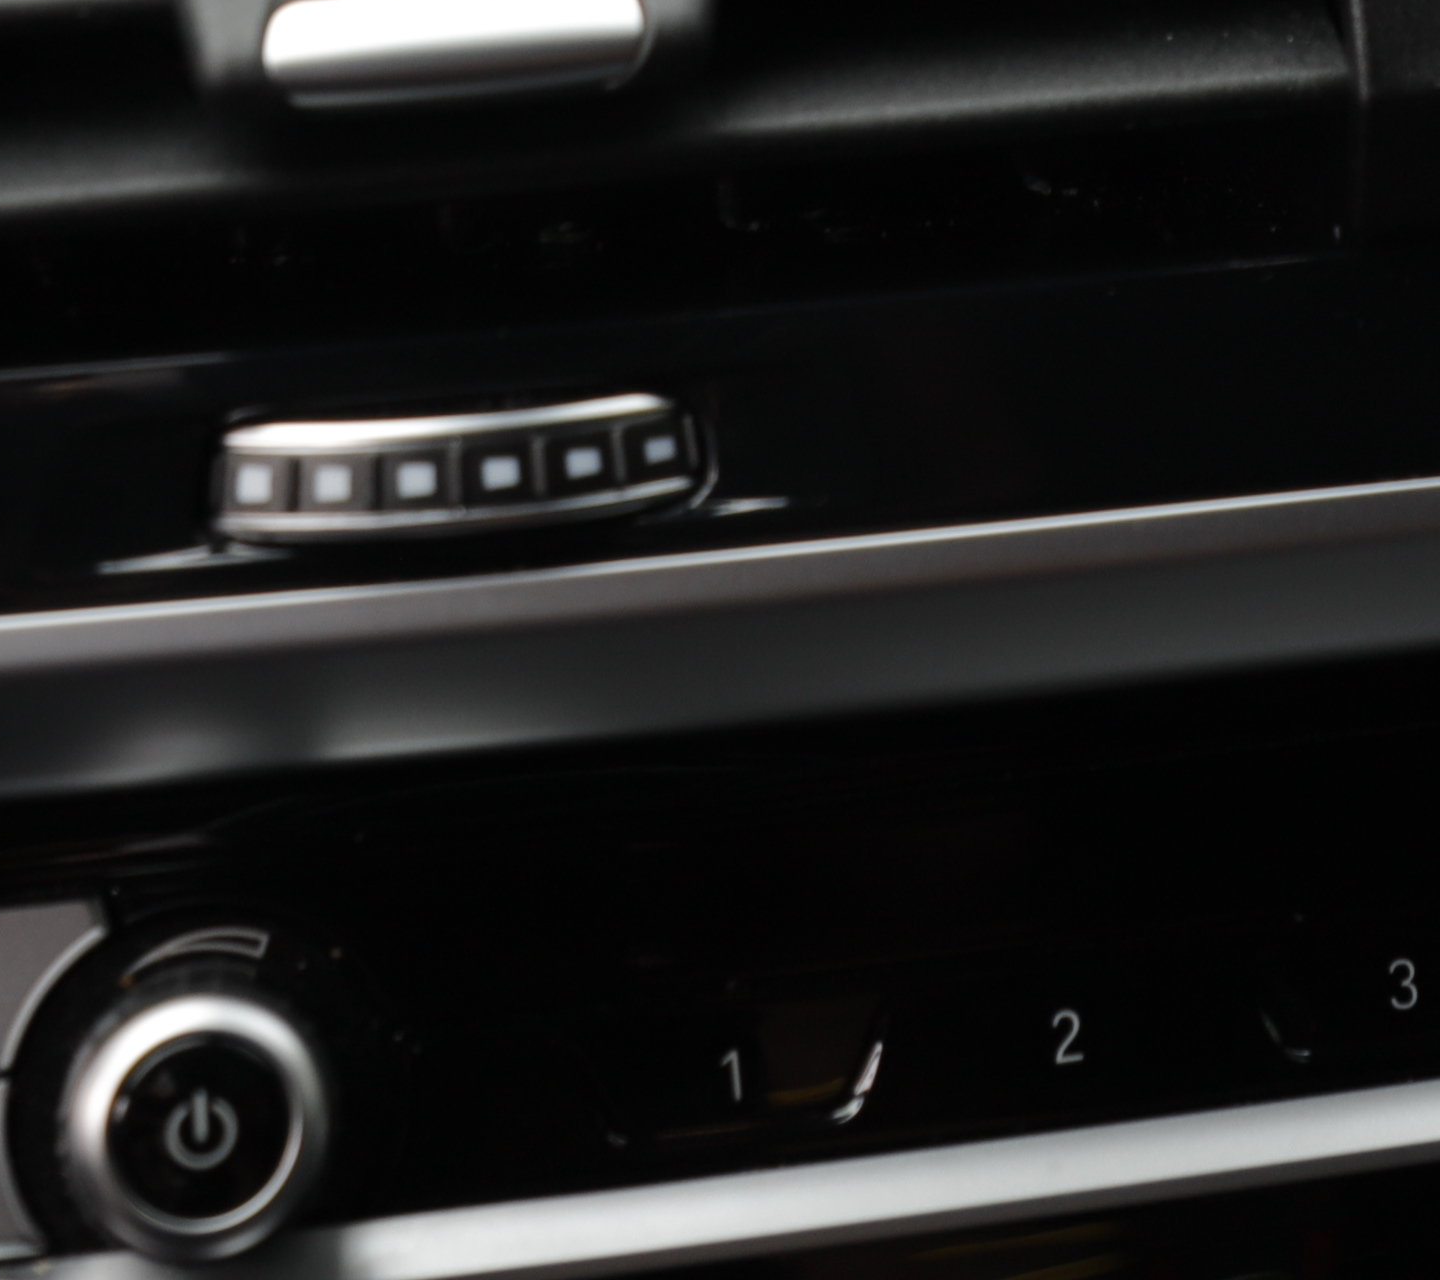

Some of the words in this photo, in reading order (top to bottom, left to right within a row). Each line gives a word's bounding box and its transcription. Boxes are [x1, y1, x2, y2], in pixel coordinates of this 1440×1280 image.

[1387, 957, 1420, 1010] 3
[1052, 1009, 1084, 1064] 2
[719, 1049, 746, 1101] 1
